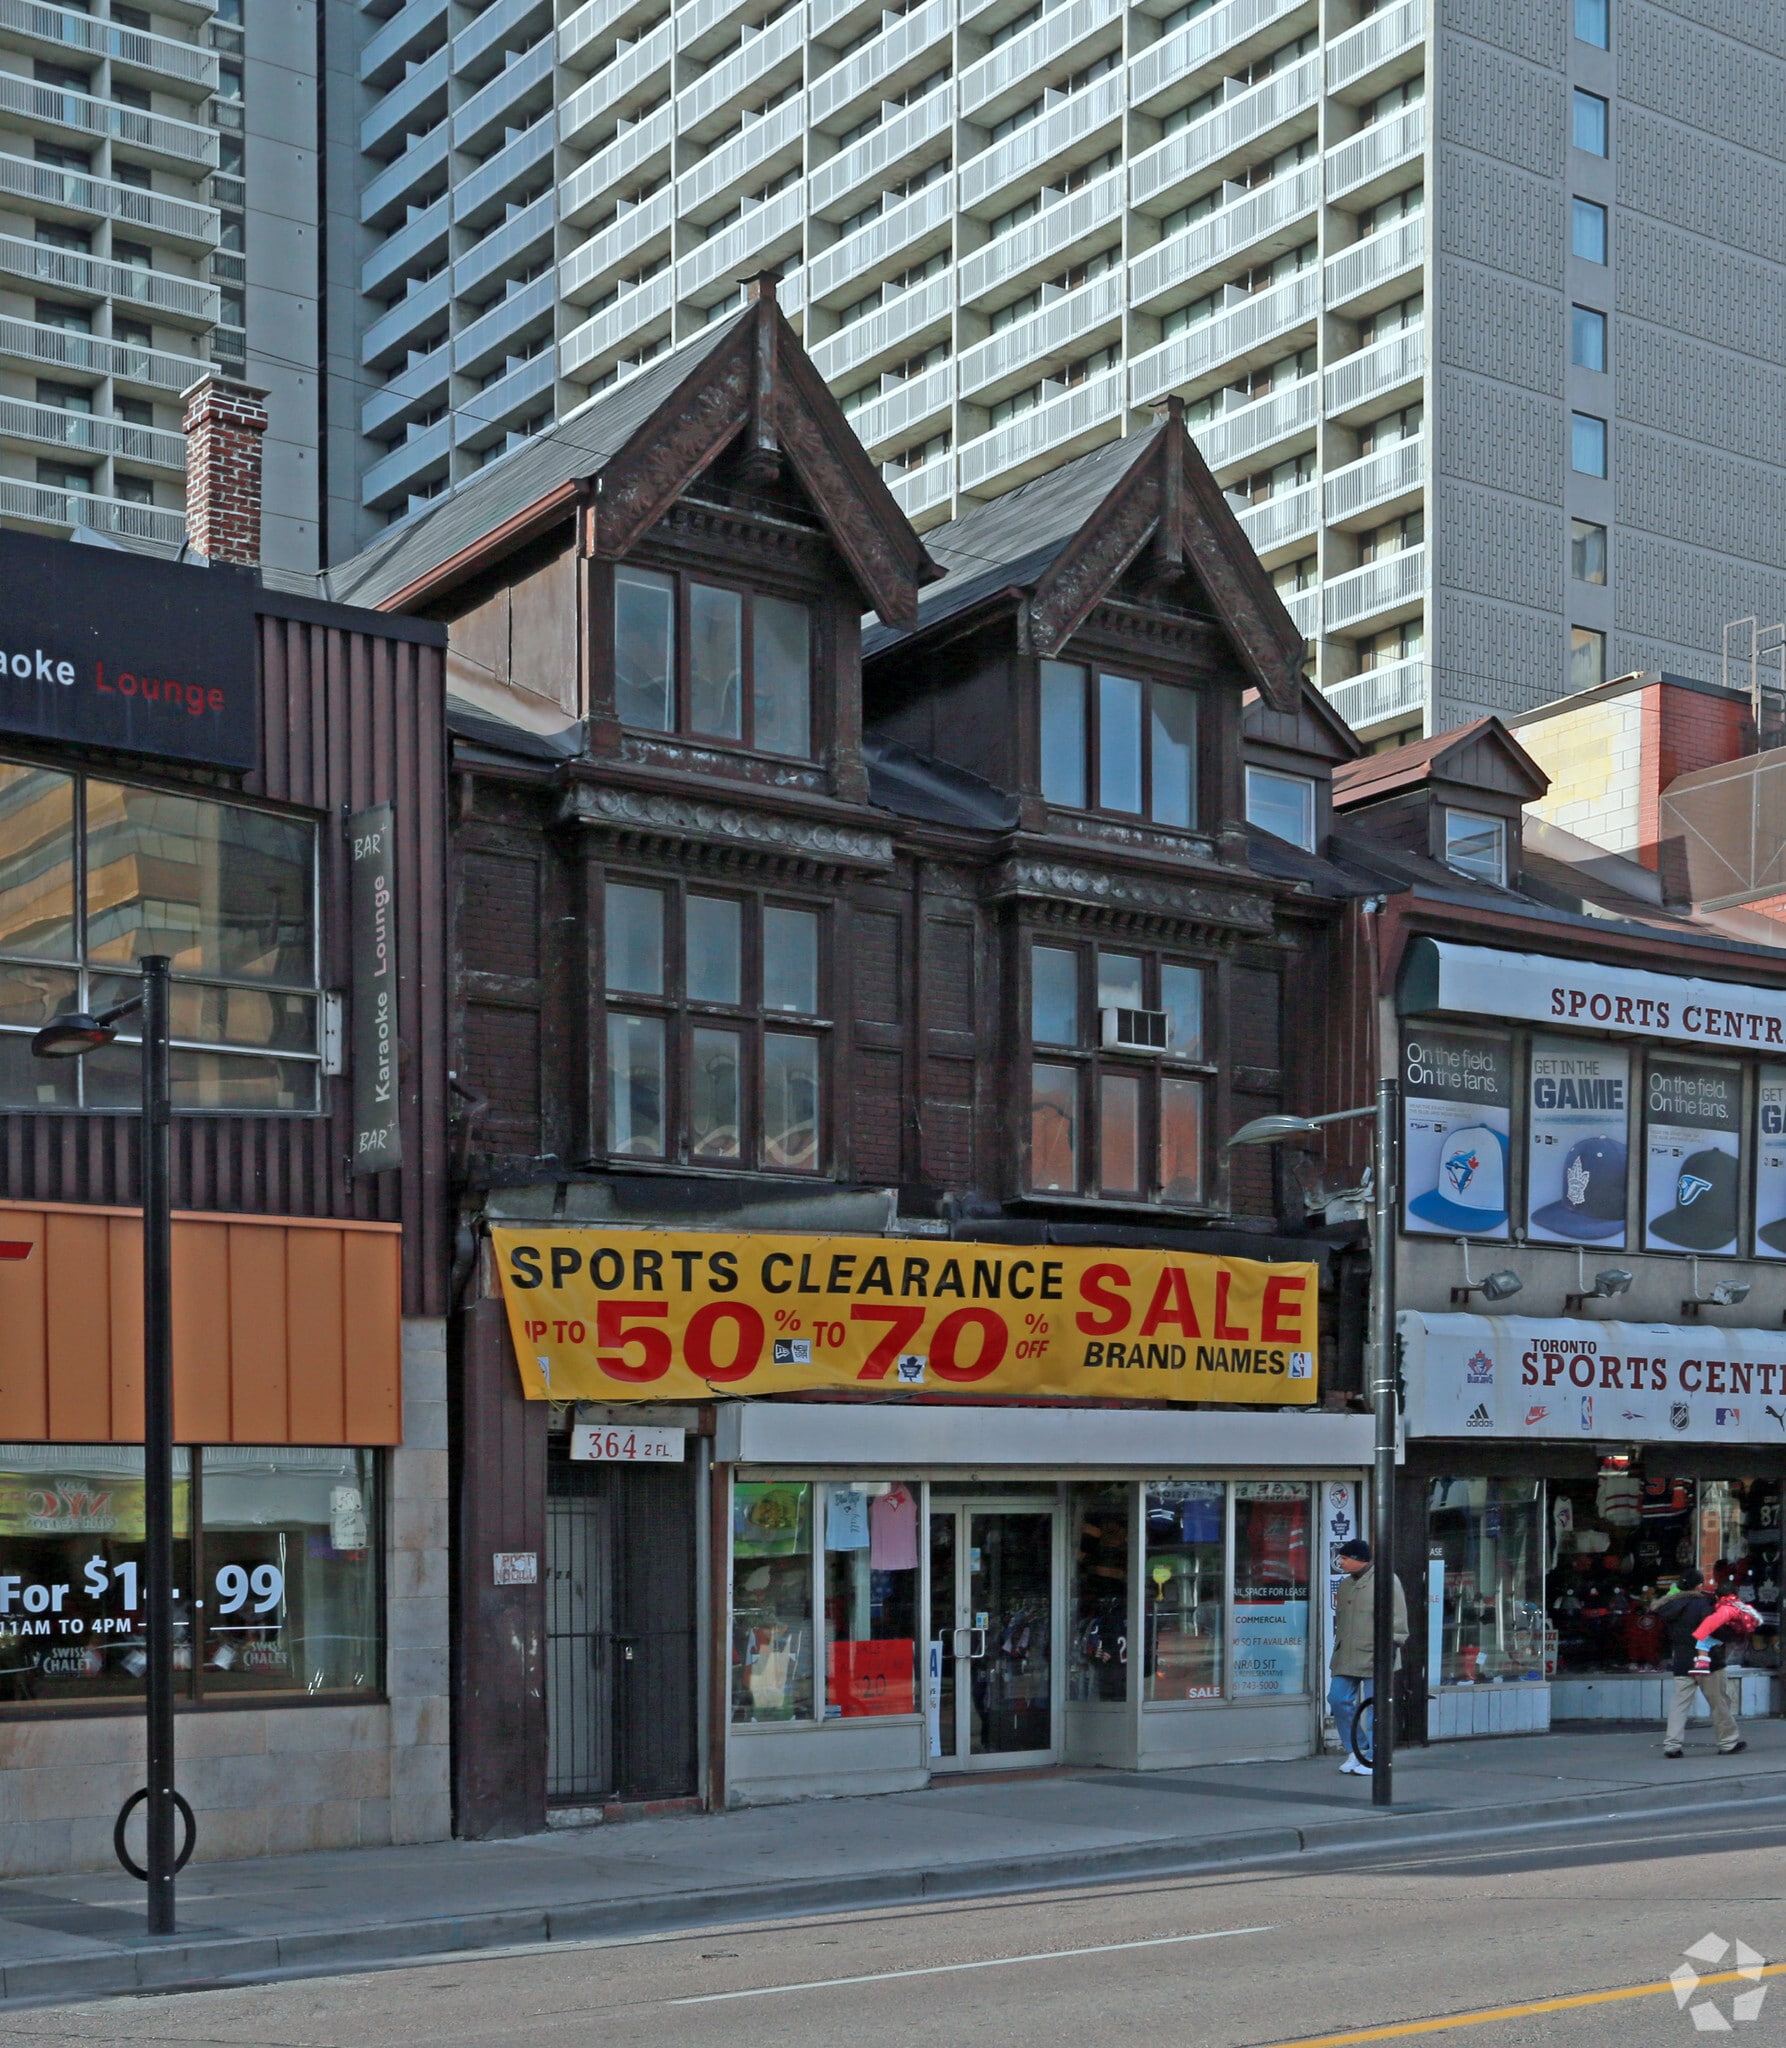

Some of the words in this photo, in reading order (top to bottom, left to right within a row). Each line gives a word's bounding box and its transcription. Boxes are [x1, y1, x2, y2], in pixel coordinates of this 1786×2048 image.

[95, 661, 225, 715] Lounge
[374, 875, 391, 975] Lounge
[1551, 988, 1670, 1029] SPORTS
[1682, 1005, 1786, 1044] CENTR
[375, 991, 390, 1102] Karaoke
[1407, 1043, 1431, 1063] On
[1432, 1045, 1460, 1068] the
[1462, 1047, 1497, 1073] field.
[1407, 1063, 1434, 1086] On
[1434, 1065, 1462, 1089] the
[1463, 1068, 1498, 1094] fans.
[1534, 1059, 1558, 1075] GET
[1561, 1060, 1573, 1076] IN
[1576, 1060, 1600, 1076] THE
[1533, 1078, 1624, 1110] GAME
[1649, 1073, 1672, 1092] On
[1674, 1074, 1697, 1096] the
[1698, 1077, 1728, 1100] field.
[1761, 1087, 1783, 1102] GET
[1649, 1092, 1672, 1112] On
[1674, 1093, 1697, 1115] the
[1698, 1095, 1729, 1120] fans.
[510, 1246, 739, 1293] SPORTS
[761, 1250, 1063, 1300] CLEARANCE
[1075, 1262, 1307, 1344] SALE
[552, 1320, 586, 1344] TO
[596, 1299, 765, 1383] 50
[774, 1309, 801, 1332] %
[812, 1320, 846, 1348] TO
[850, 1302, 1009, 1383] 70
[1024, 1313, 1049, 1334] %
[1015, 1339, 1050, 1360] OFF
[1531, 1338, 1597, 1355] TORONTO
[1083, 1341, 1186, 1370] BRAND
[1195, 1346, 1285, 1376] NAMES
[1521, 1351, 1667, 1391] SPORTS
[1466, 1419, 1494, 1428] adidas
[588, 1432, 637, 1459] 364
[644, 1443, 652, 1457] 2
[0, 1575, 69, 1613] For
[1245, 1587, 1268, 1597] SPACE
[1268, 1587, 1284, 1597] FOR
[1285, 1587, 1307, 1597] LEASE
[0, 1619, 51, 1635] 11AM
[58, 1618, 84, 1634] TO
[91, 1617, 132, 1633] 4PM
[1235, 1615, 1287, 1624] COMMERCIAL
[52, 1647, 85, 1659] SWISS
[1253, 1637, 1262, 1646] FT
[1263, 1637, 1302, 1646] AVAILABLE
[43, 1658, 92, 1673] CHALET
[1263, 1659, 1277, 1670] SIT
[1189, 1687, 1221, 1698] SALE
